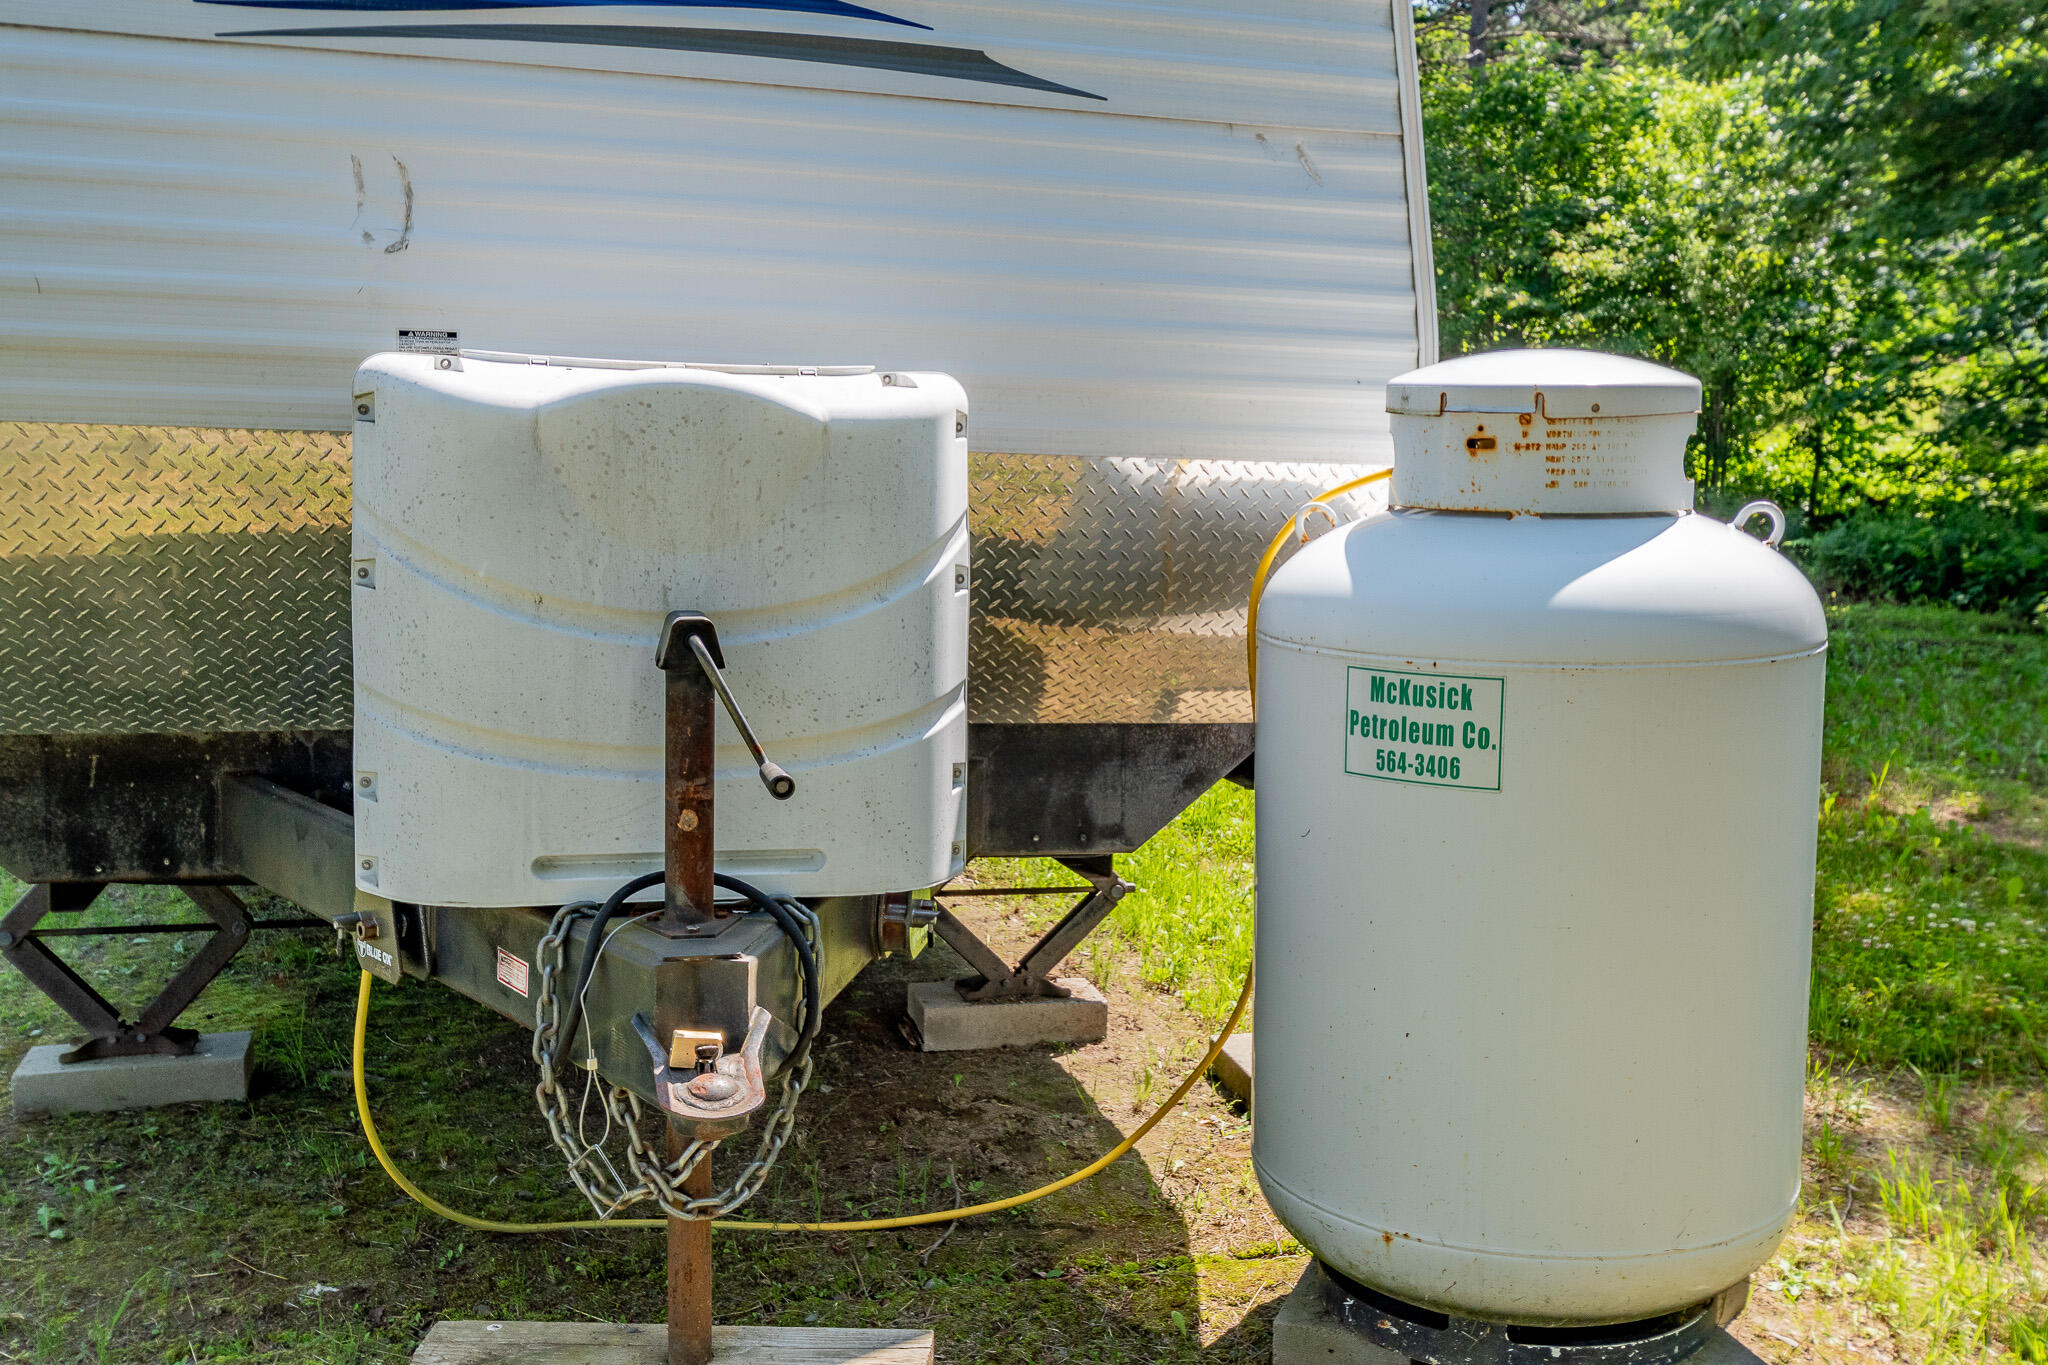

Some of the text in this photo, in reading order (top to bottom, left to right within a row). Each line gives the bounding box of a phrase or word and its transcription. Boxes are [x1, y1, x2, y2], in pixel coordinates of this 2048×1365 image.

[1370, 675, 1473, 711] McKusick
[1350, 709, 1497, 750] Petroleum Co.
[1376, 748, 1461, 780] 564-3406
[366, 943, 392, 967] BLUE OX
